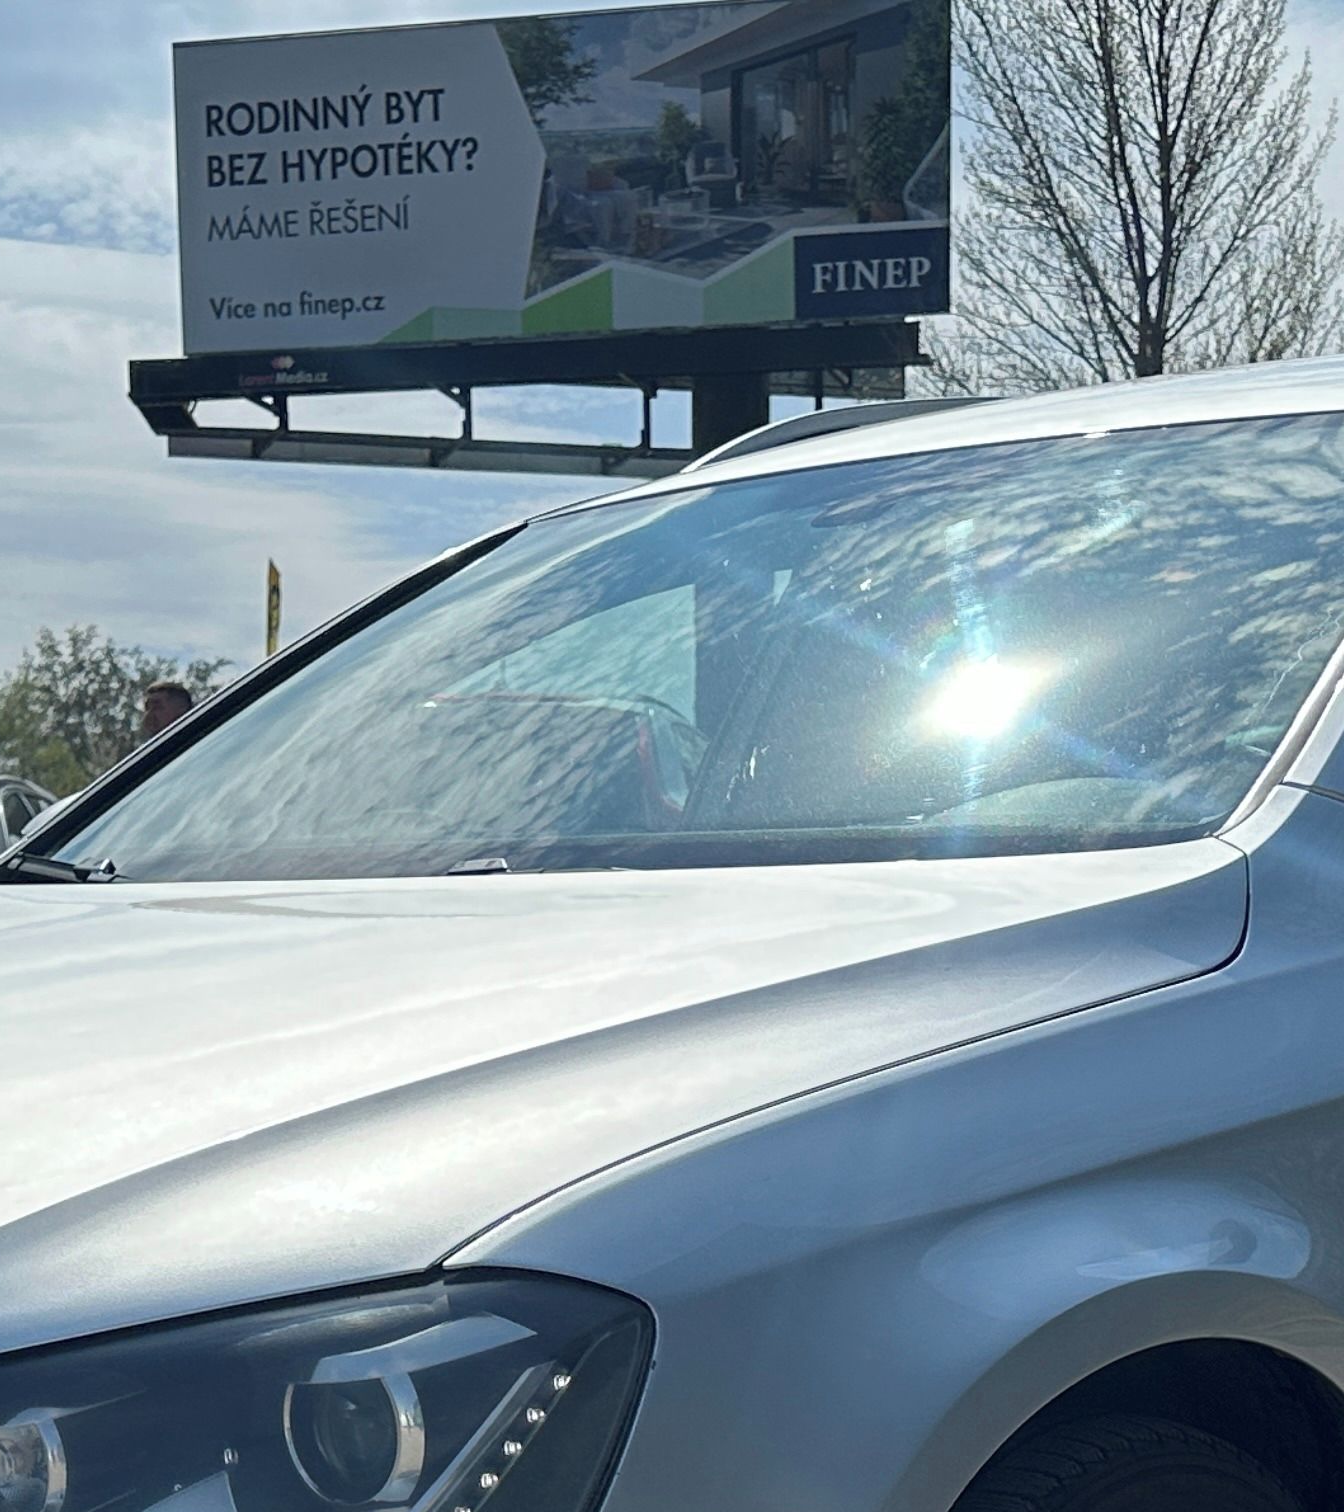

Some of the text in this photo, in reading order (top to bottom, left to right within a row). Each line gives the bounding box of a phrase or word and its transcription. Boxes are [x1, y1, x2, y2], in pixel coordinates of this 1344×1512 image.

[205, 84, 445, 137] RODINNÝ BYT
[207, 133, 478, 187] BEZ HYPOTÉKY?
[207, 195, 410, 242] MÁME ŘEŠENÍ
[812, 256, 932, 294] FINEP
[209, 290, 386, 320] Více na finep.cz
